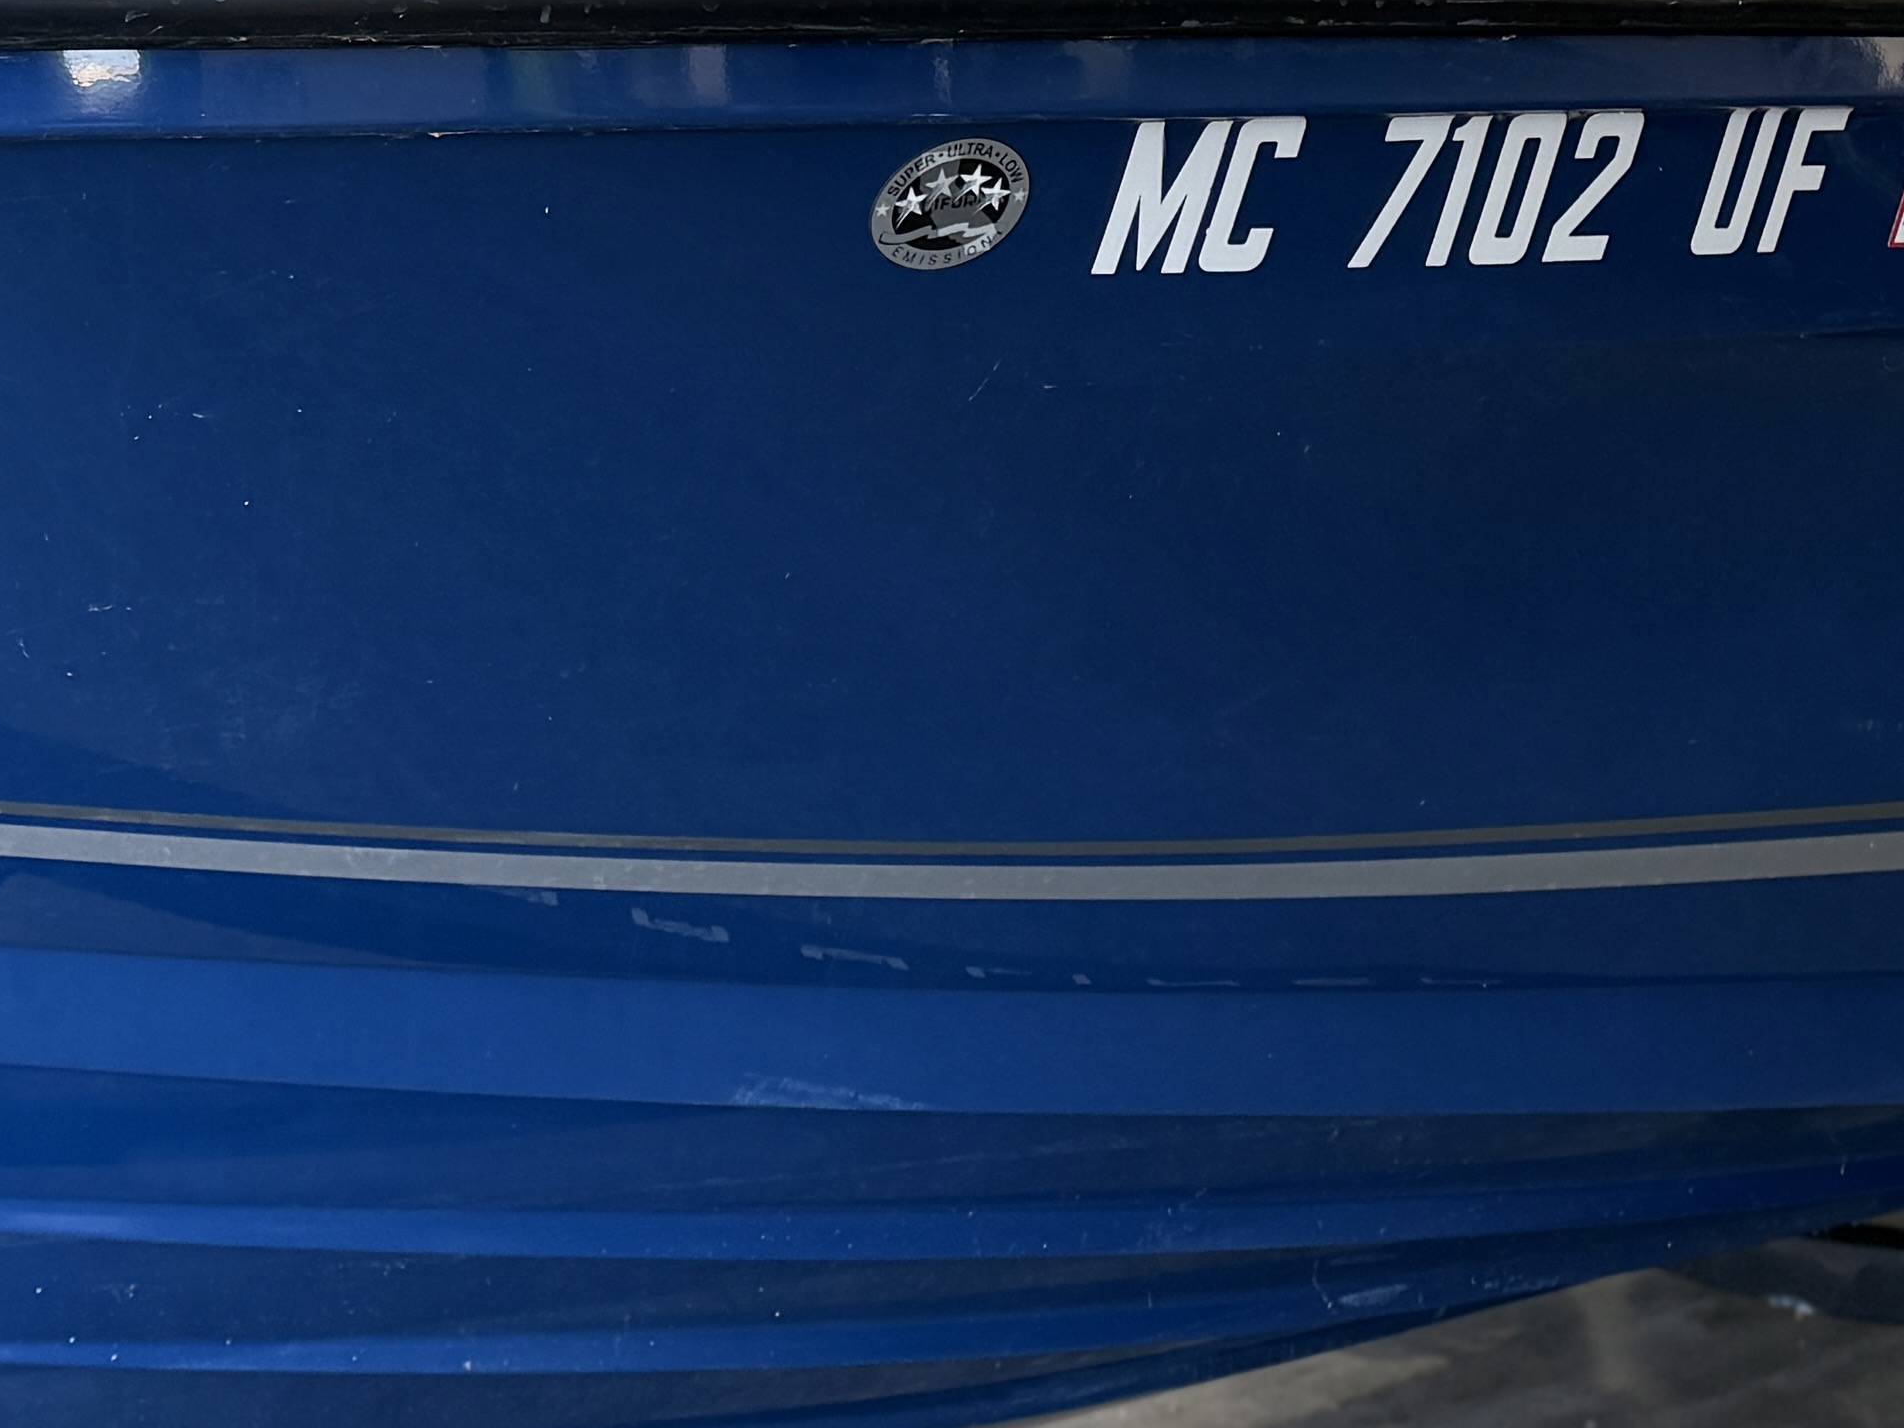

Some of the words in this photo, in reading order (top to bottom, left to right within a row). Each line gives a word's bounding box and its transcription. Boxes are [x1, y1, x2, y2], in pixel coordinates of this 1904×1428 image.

[887, 153, 937, 197] SUPER
[946, 141, 994, 159] ULTRA
[998, 152, 1025, 184] LOW
[1091, 115, 1308, 275] MC
[1346, 110, 1645, 268] 7102
[1690, 107, 1853, 255] UF
[892, 236, 995, 266] EMISSION
